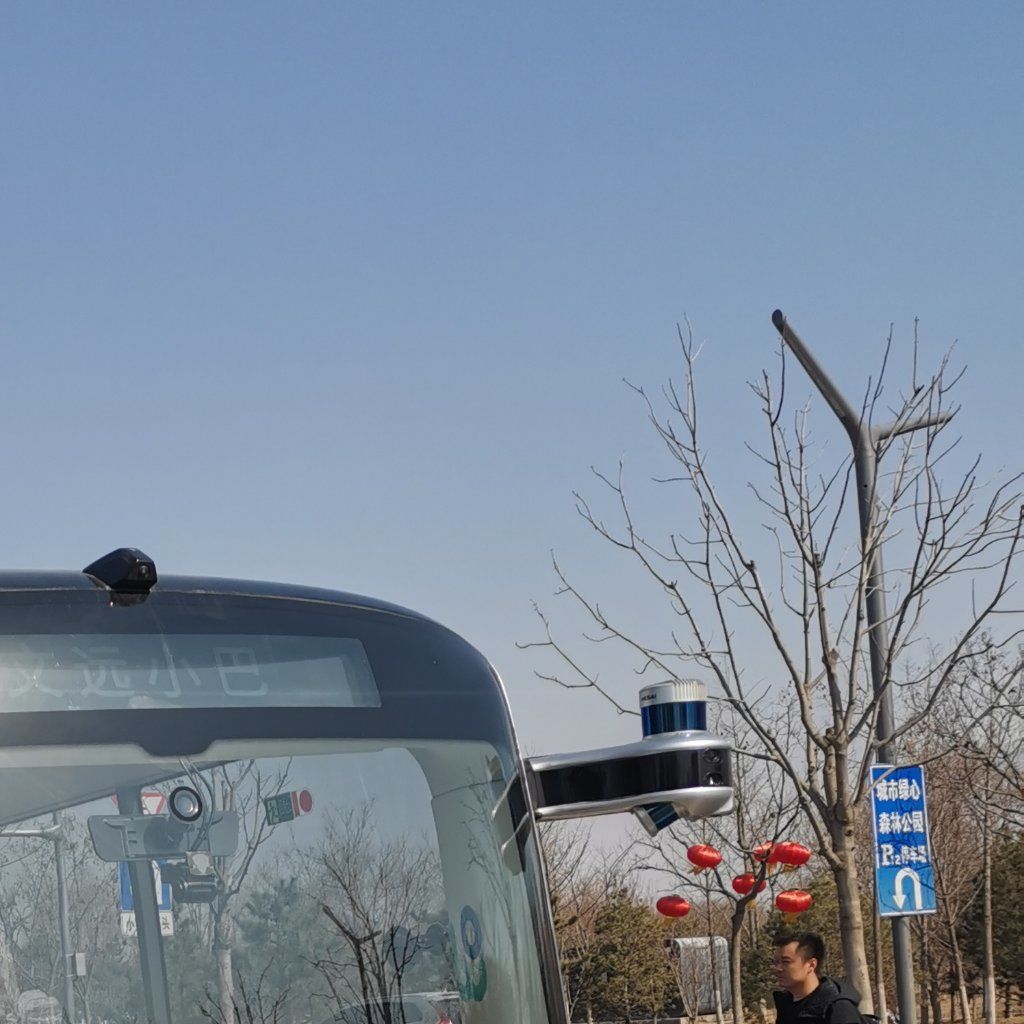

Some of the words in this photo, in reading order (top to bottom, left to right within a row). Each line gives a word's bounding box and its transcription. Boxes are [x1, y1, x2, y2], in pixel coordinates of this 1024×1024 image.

[877, 778, 920, 801] 城市绿心
[879, 811, 924, 834] 森林公园
